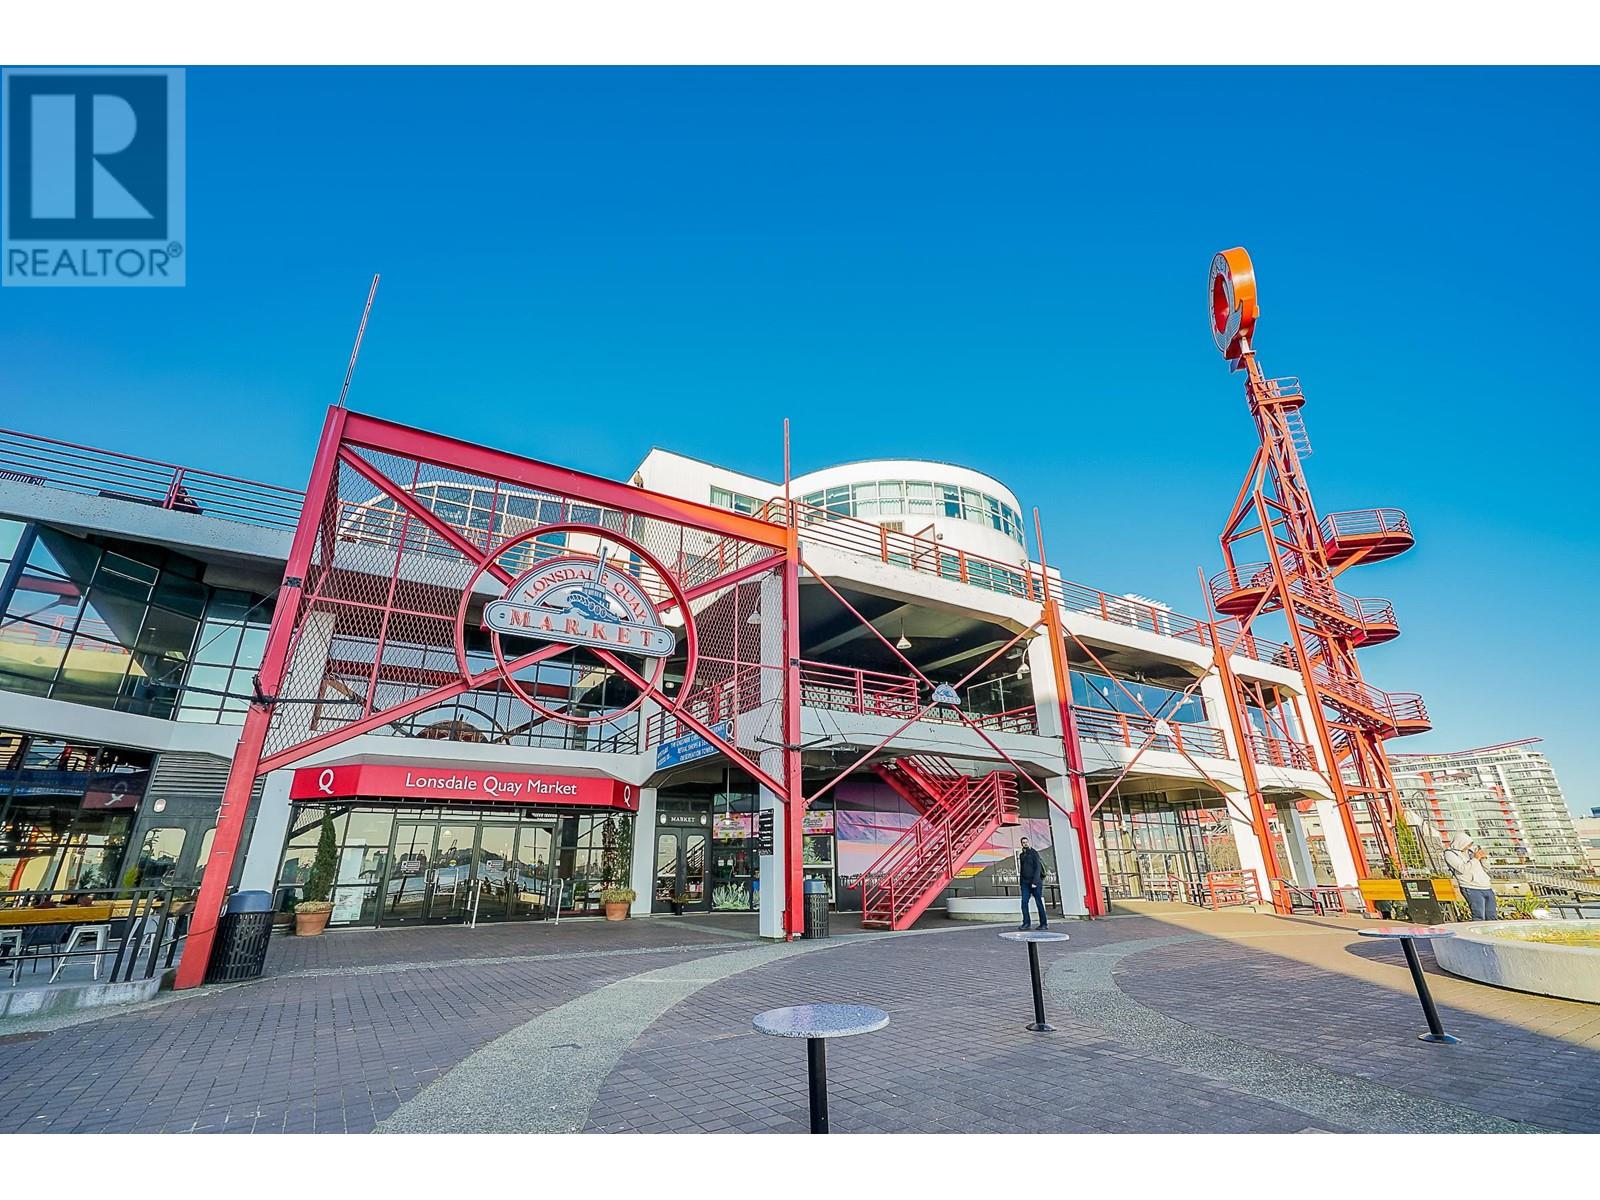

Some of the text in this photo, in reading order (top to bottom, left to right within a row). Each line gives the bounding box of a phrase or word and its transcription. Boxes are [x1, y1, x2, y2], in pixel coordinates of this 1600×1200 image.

[524, 568, 647, 618] LONSDALE QUAY
[508, 609, 654, 647] MARKET
[318, 768, 336, 795] Q
[405, 772, 577, 797] Lonsdale Quay Market
[623, 784, 632, 808] Q
